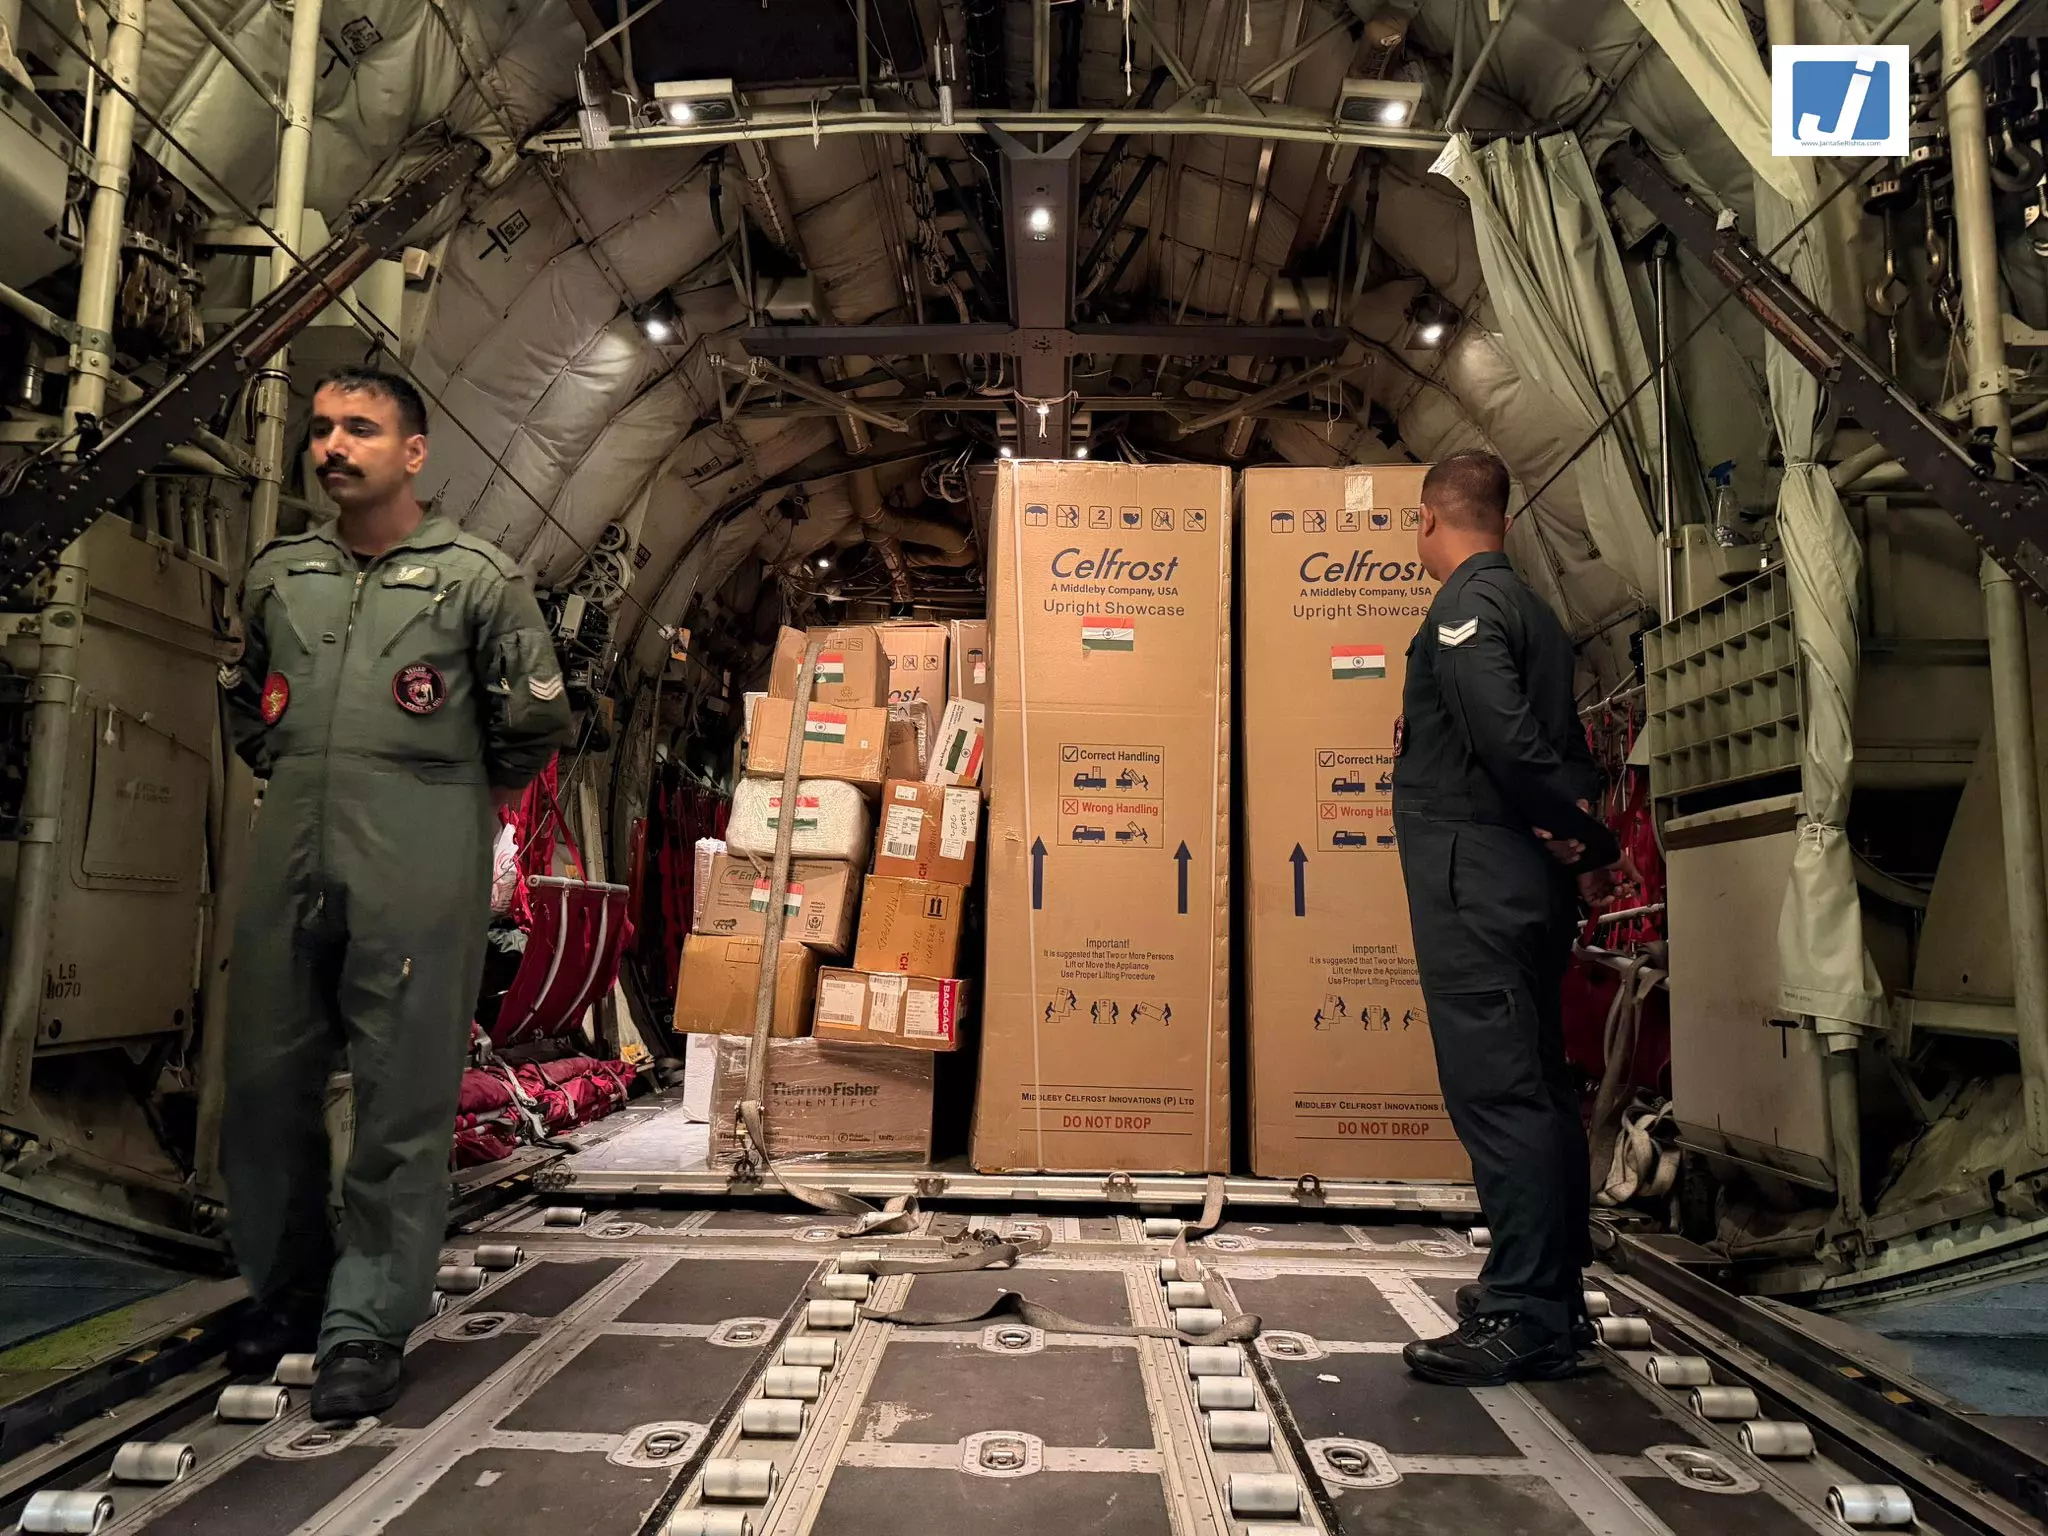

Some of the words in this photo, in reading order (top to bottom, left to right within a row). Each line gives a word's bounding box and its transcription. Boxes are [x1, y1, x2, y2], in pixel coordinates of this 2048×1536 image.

[1052, 548, 1178, 581] Celfrost
[1061, 584, 1105, 595] Middleby
[1108, 586, 1155, 596] Company,
[1158, 587, 1178, 596] USA
[1311, 588, 1356, 598] Middleby
[1359, 587, 1407, 597] Company,
[1411, 587, 1432, 595] USA
[1044, 600, 1100, 615] Upright
[1105, 602, 1185, 616] Showcase
[1293, 604, 1352, 620] Upright
[1357, 604, 1429, 616] Showcas
[1080, 750, 1115, 760] Correct
[1118, 752, 1160, 764] Handling
[1337, 755, 1373, 764] Correct
[1082, 802, 1113, 814] Wrong
[1116, 804, 1158, 816] Handling
[1340, 807, 1373, 818] Wrong
[1086, 938, 1129, 949] Important!
[1057, 950, 1090, 959] suggested
[1092, 951, 1105, 959] that
[1106, 951, 1119, 959] Two
[1129, 952, 1145, 960] More
[1147, 952, 1174, 960] Persons
[1352, 944, 1398, 955] Important!
[1086, 961, 1104, 969] Move
[1105, 961, 1115, 969] the
[1116, 962, 1149, 971] Appliance
[1322, 957, 1357, 966] suggested
[59, 963, 76, 980] LS
[1061, 970, 1074, 978] Use
[1075, 971, 1098, 980] Proper
[1099, 971, 1120, 981] Lifting
[1121, 972, 1156, 980] Procedure
[1332, 967, 1344, 975] Lift
[1353, 967, 1372, 975] Move
[1373, 967, 1384, 975] the
[1328, 977, 1342, 985] Use
[1343, 977, 1366, 986] Proper
[1368, 977, 1389, 987] Lifting
[1390, 977, 1419, 985] Procedu
[773, 1098, 877, 1107] SCIENTIFIC
[1164, 1096, 1176, 1106] (P)
[1063, 1115, 1081, 1128] DO
[1085, 1116, 1112, 1129] NOT
[1115, 1117, 1151, 1130] DROP
[1338, 1121, 1357, 1134] DO
[1361, 1122, 1388, 1134] NOT
[1392, 1123, 1430, 1135] DROP
